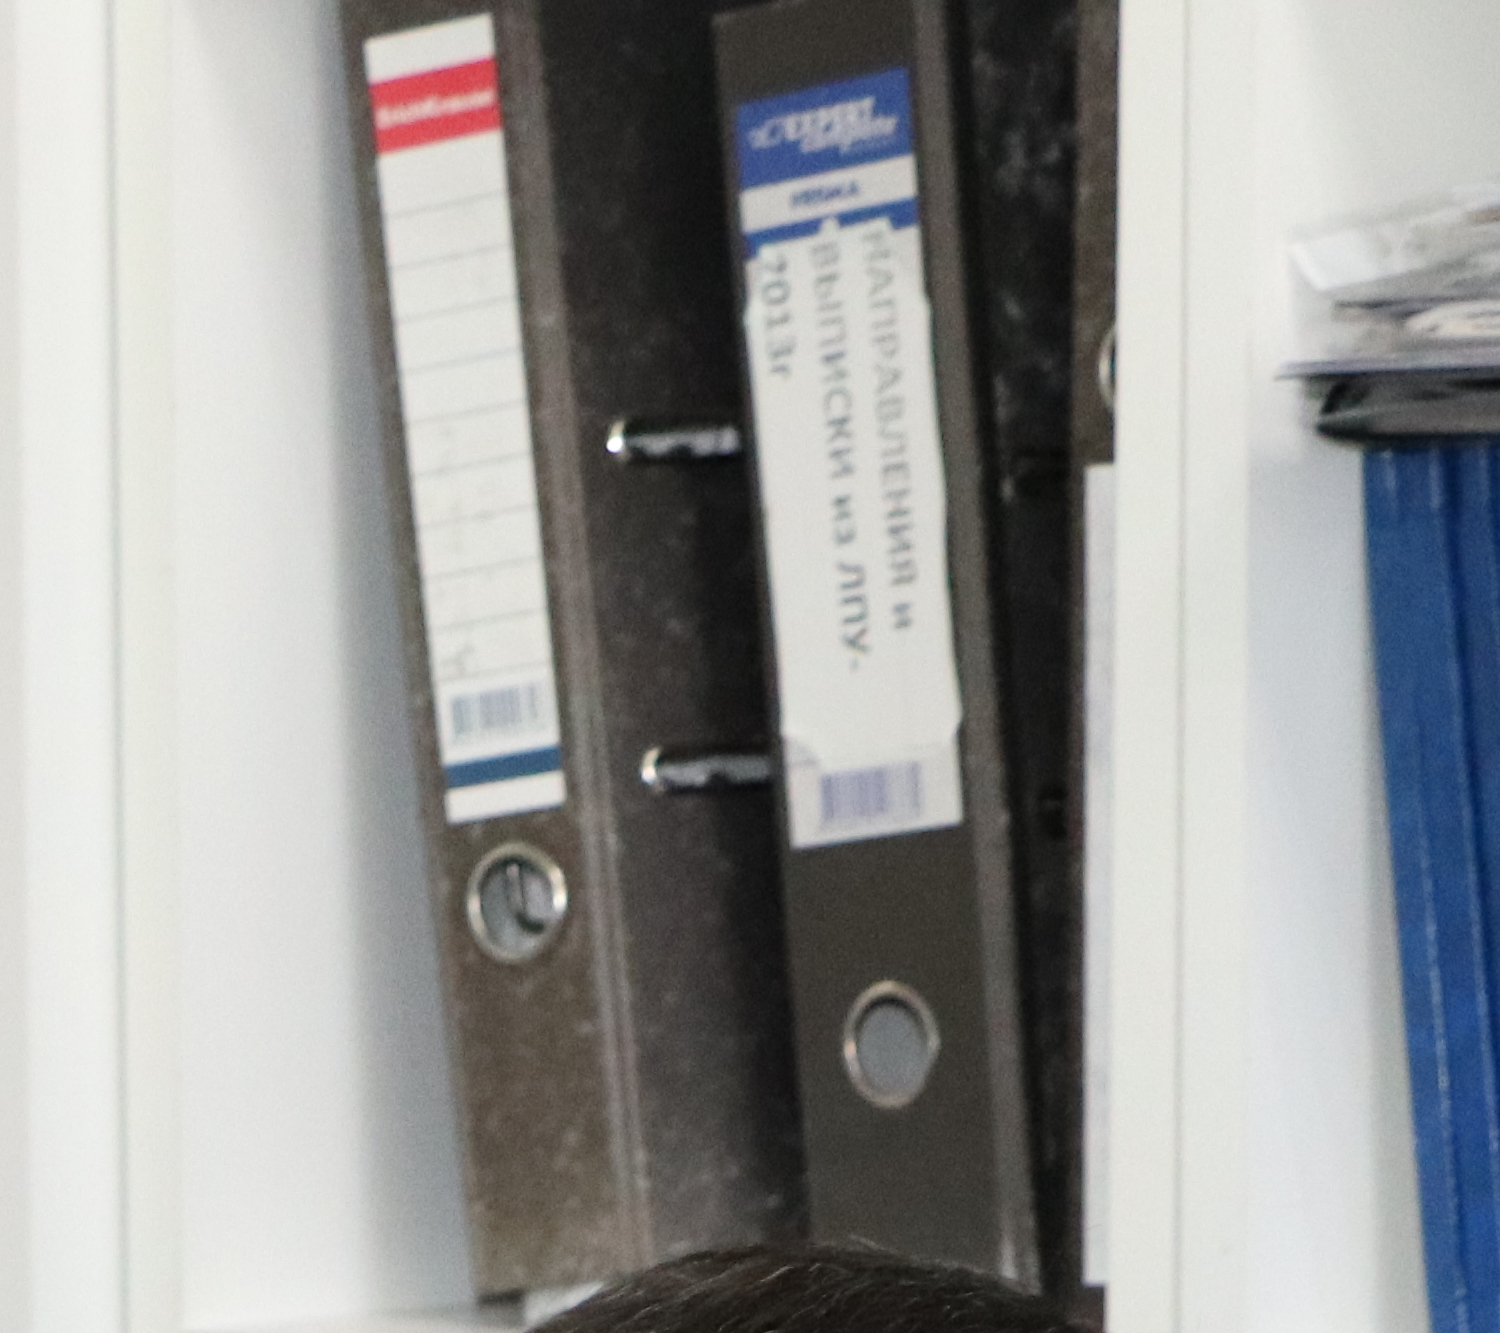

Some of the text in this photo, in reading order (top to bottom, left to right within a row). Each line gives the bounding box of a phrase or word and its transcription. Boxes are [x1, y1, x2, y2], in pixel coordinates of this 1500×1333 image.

[807, 238, 862, 483] ВЫПИСКИ
[860, 229, 919, 633] НАПРАВЛЕНИЯ и
[832, 494, 860, 550] из
